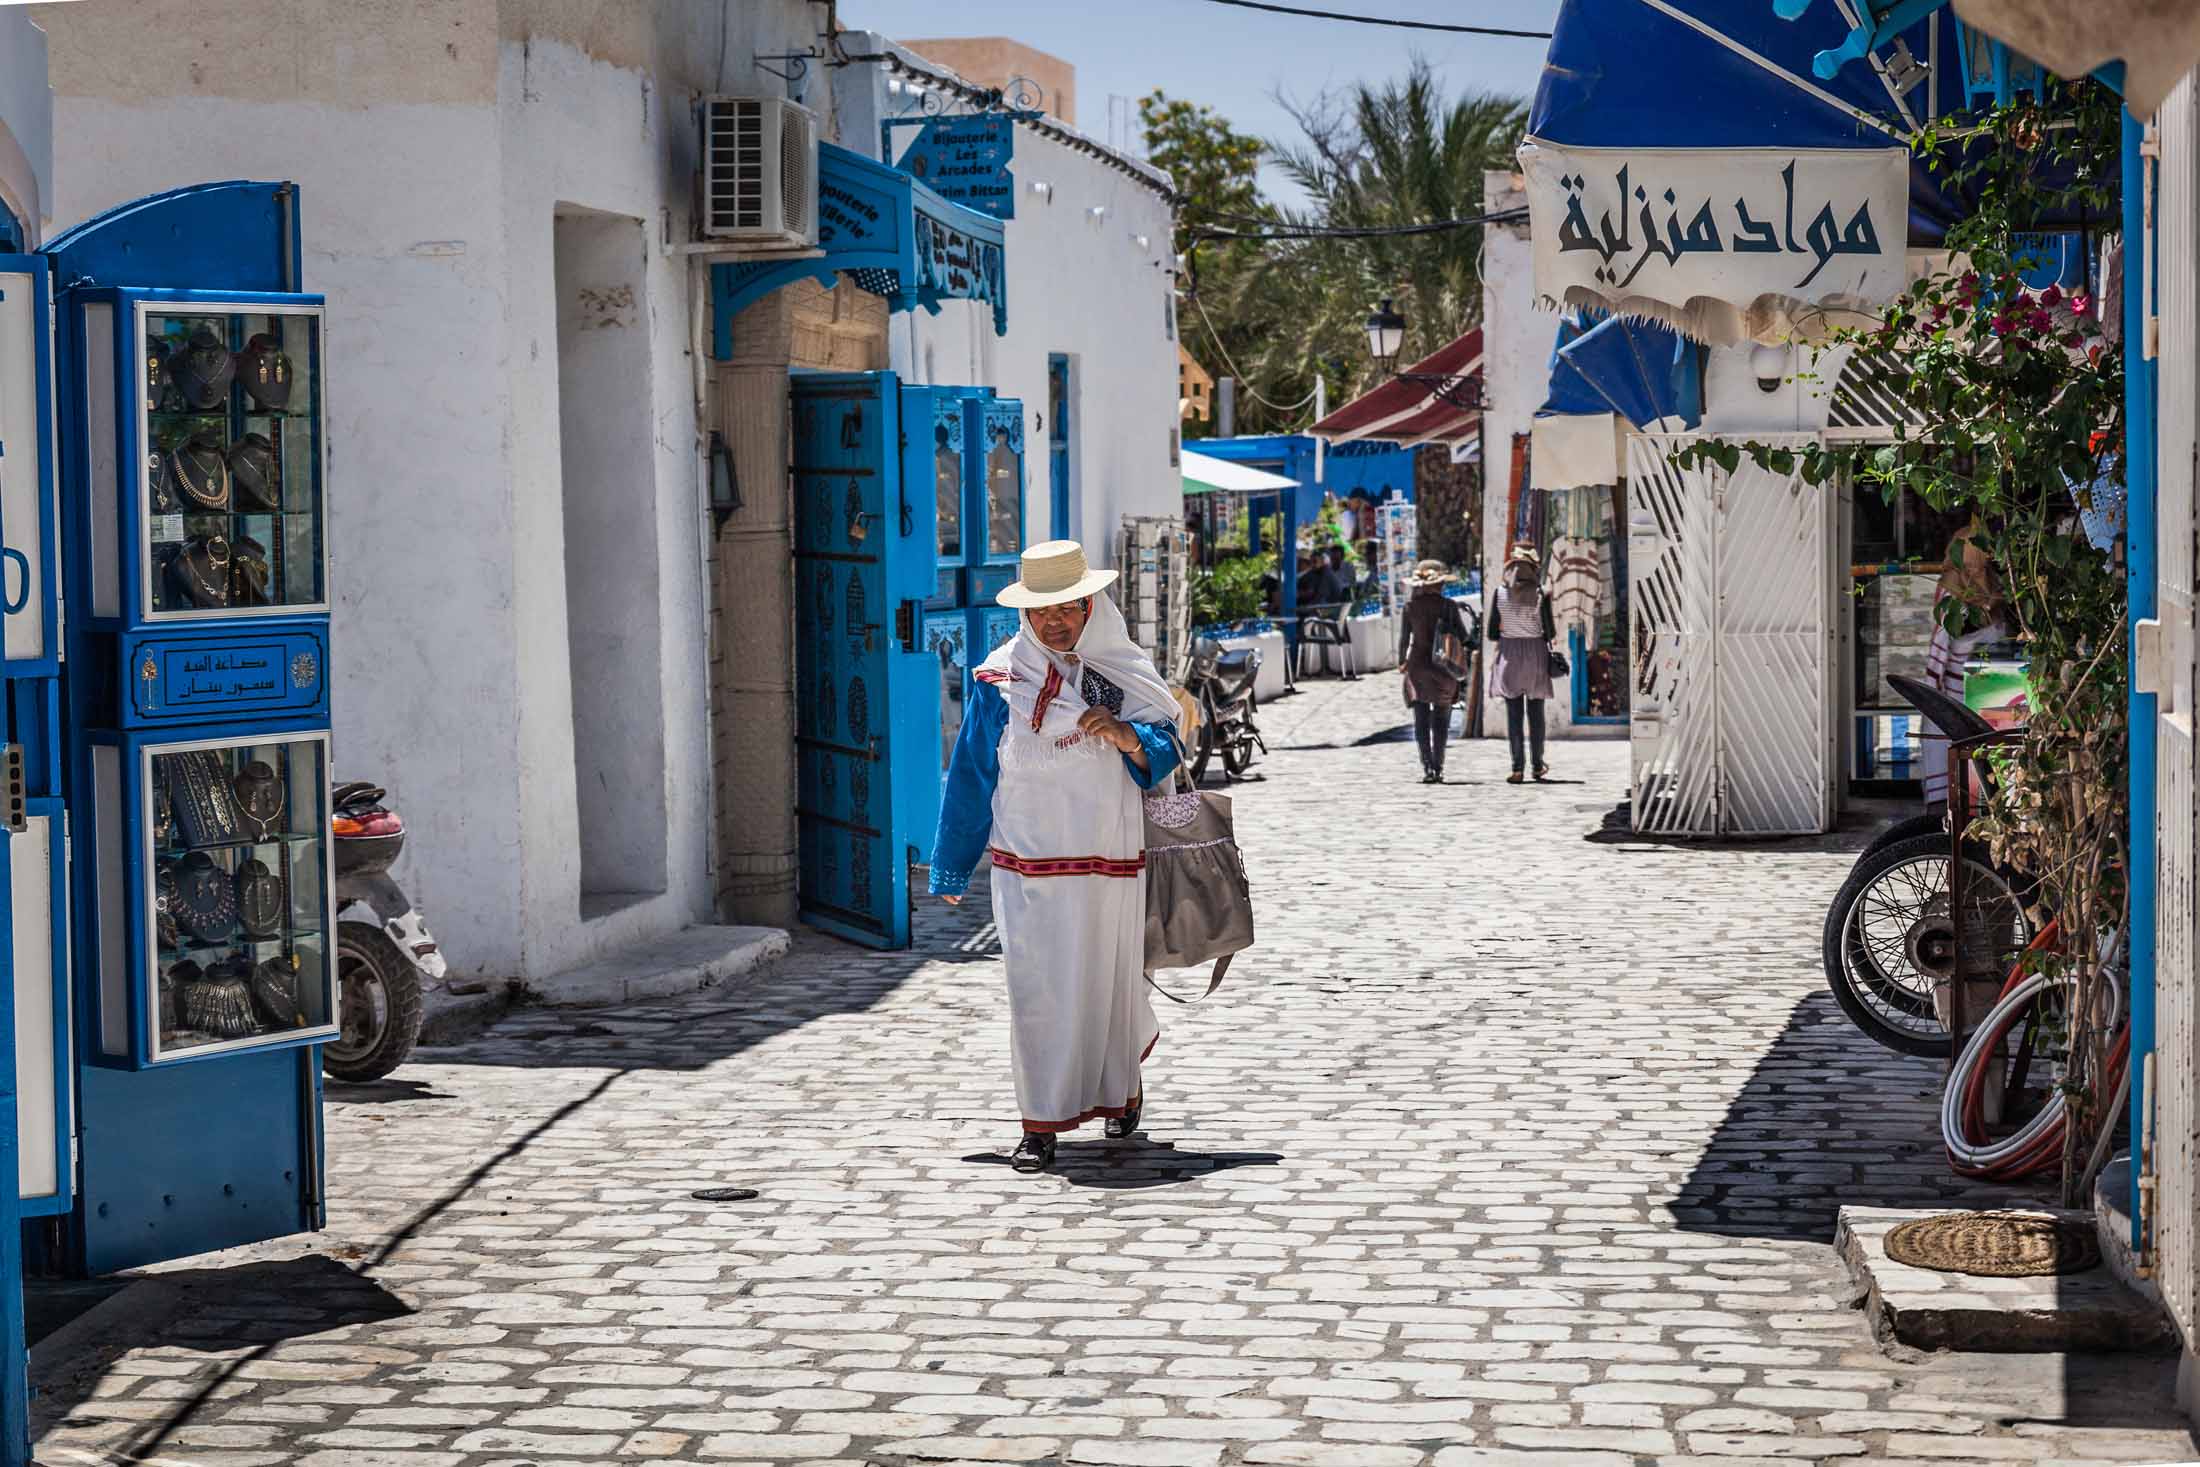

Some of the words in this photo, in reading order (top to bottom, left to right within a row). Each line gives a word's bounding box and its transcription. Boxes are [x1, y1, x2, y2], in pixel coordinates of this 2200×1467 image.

[933, 131, 998, 147] Bijouterie
[956, 148, 978, 161] Les
[937, 161, 993, 176] Arcades
[1559, 163, 1724, 288] منزلية
[1733, 158, 1882, 288] مواد
